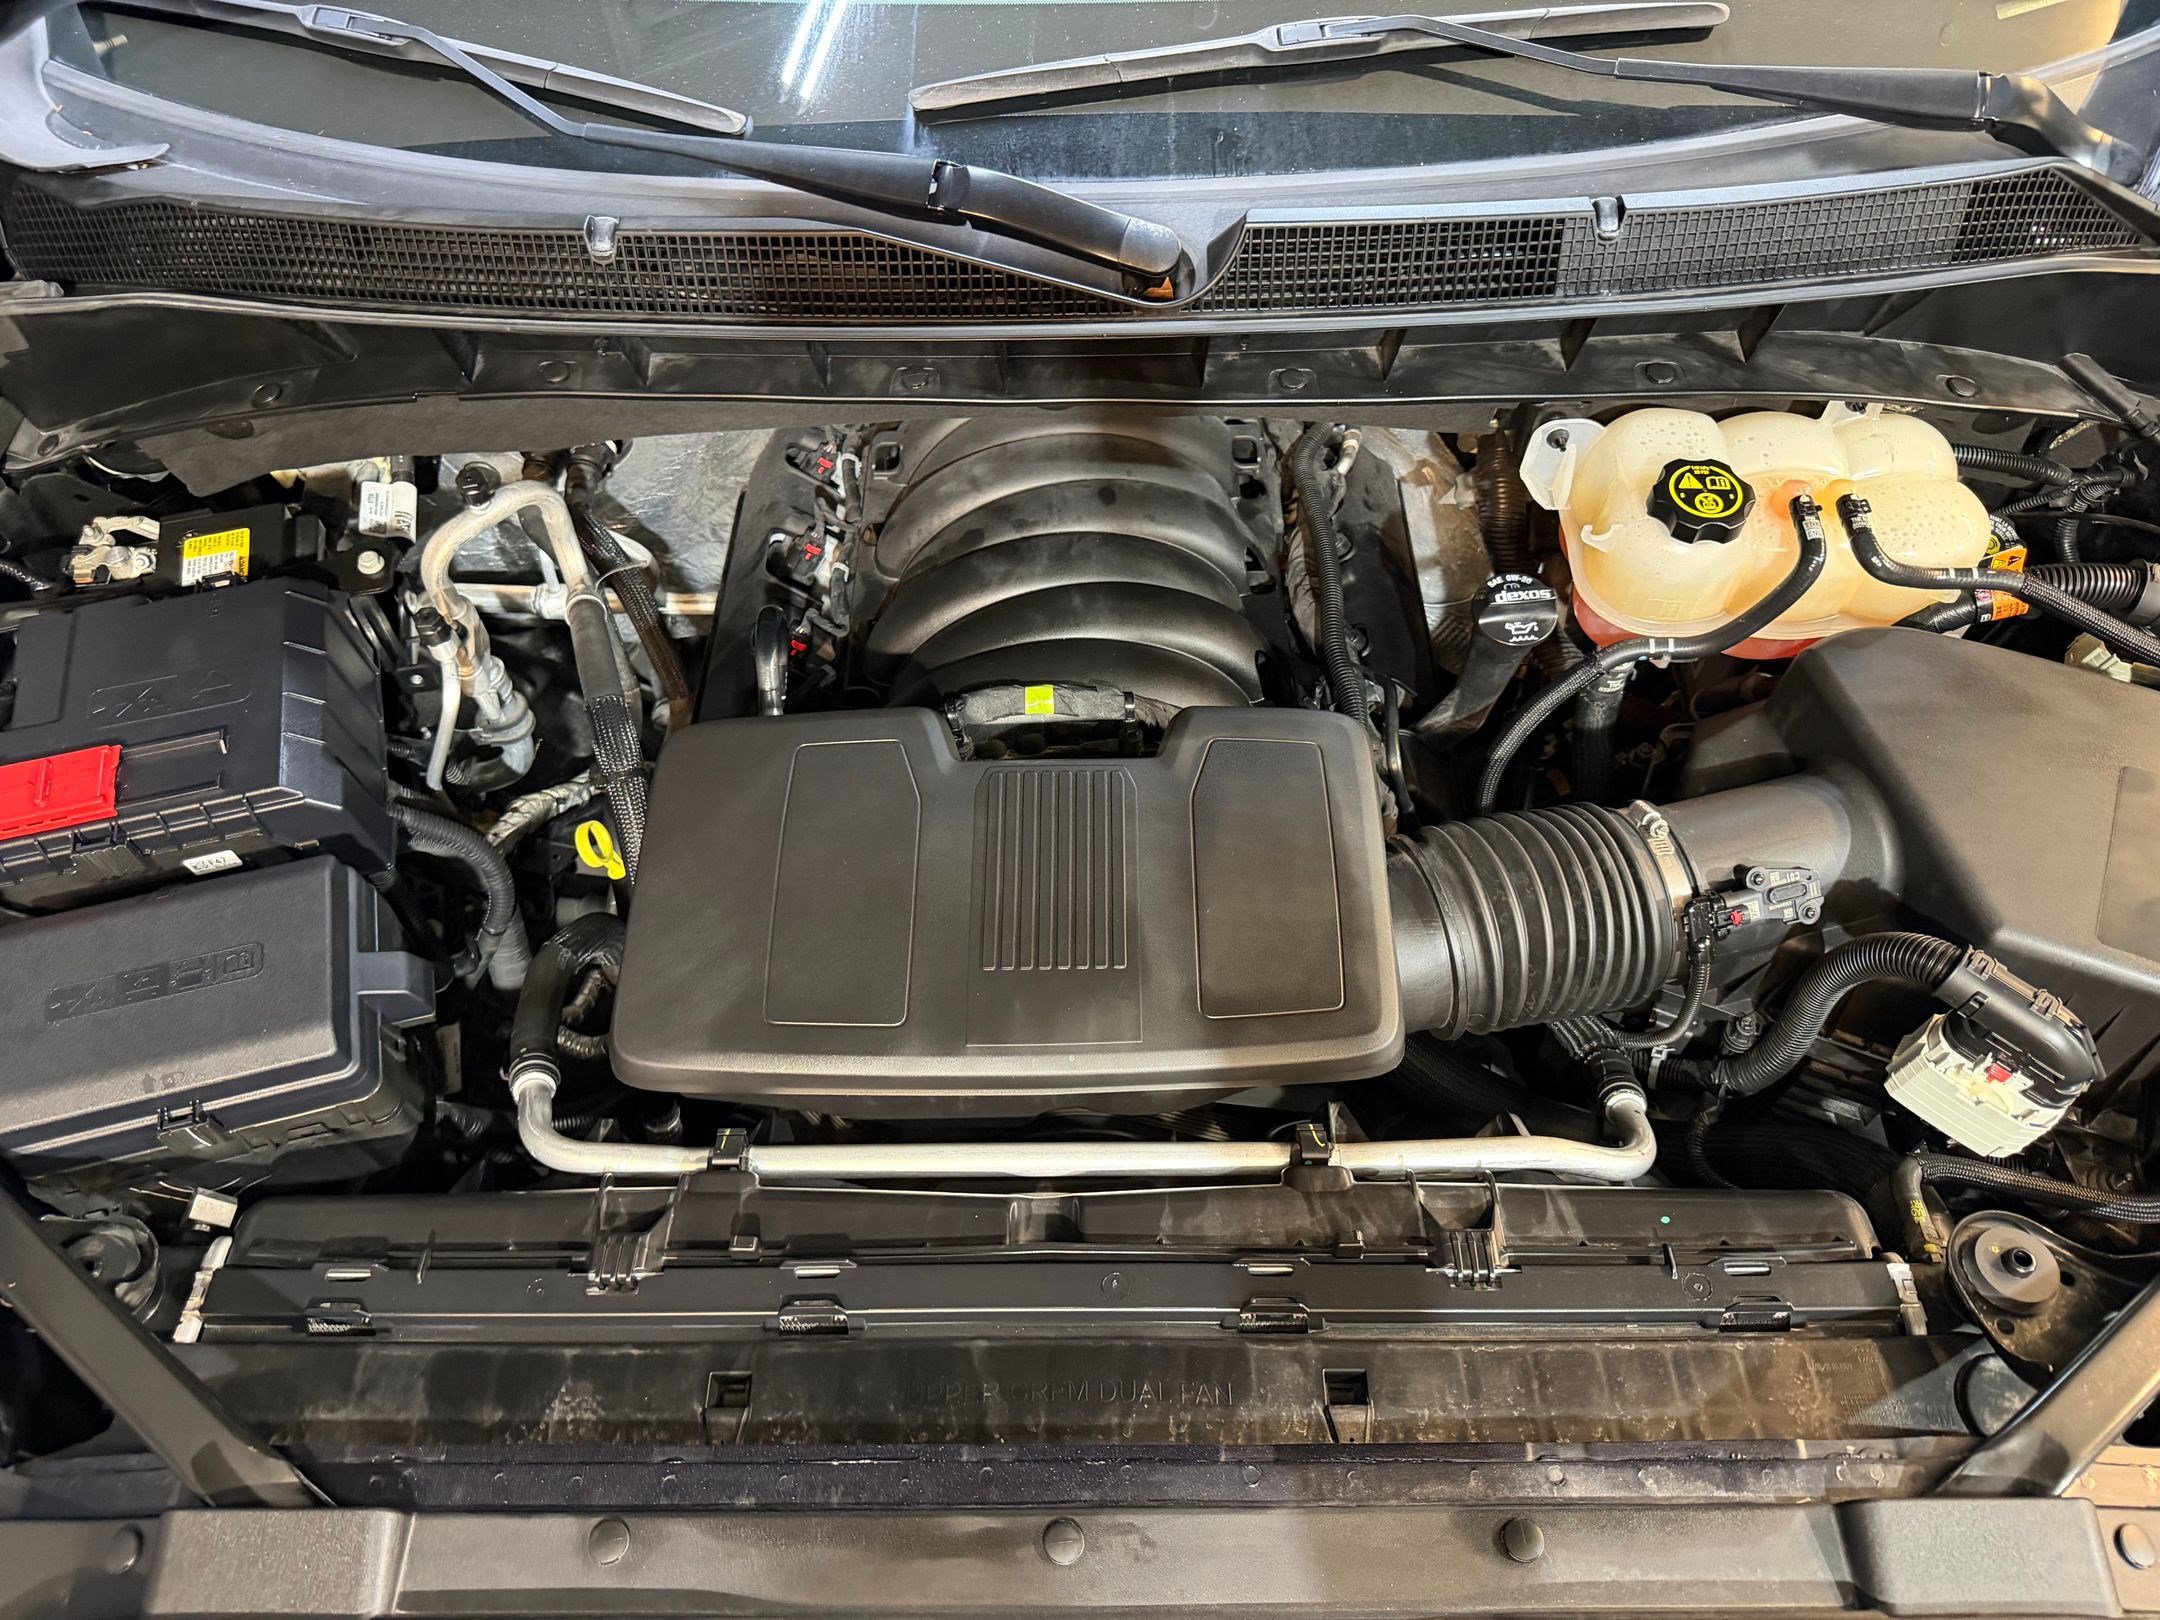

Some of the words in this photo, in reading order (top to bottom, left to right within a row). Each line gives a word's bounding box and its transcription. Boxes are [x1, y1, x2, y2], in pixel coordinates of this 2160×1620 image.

[1487, 576, 1504, 588] SAE
[1505, 574, 1533, 584] 0W-20
[1495, 590, 1551, 602] dexos
[1099, 1379, 1173, 1403] DUAL
[1181, 1381, 1234, 1405] FAN
